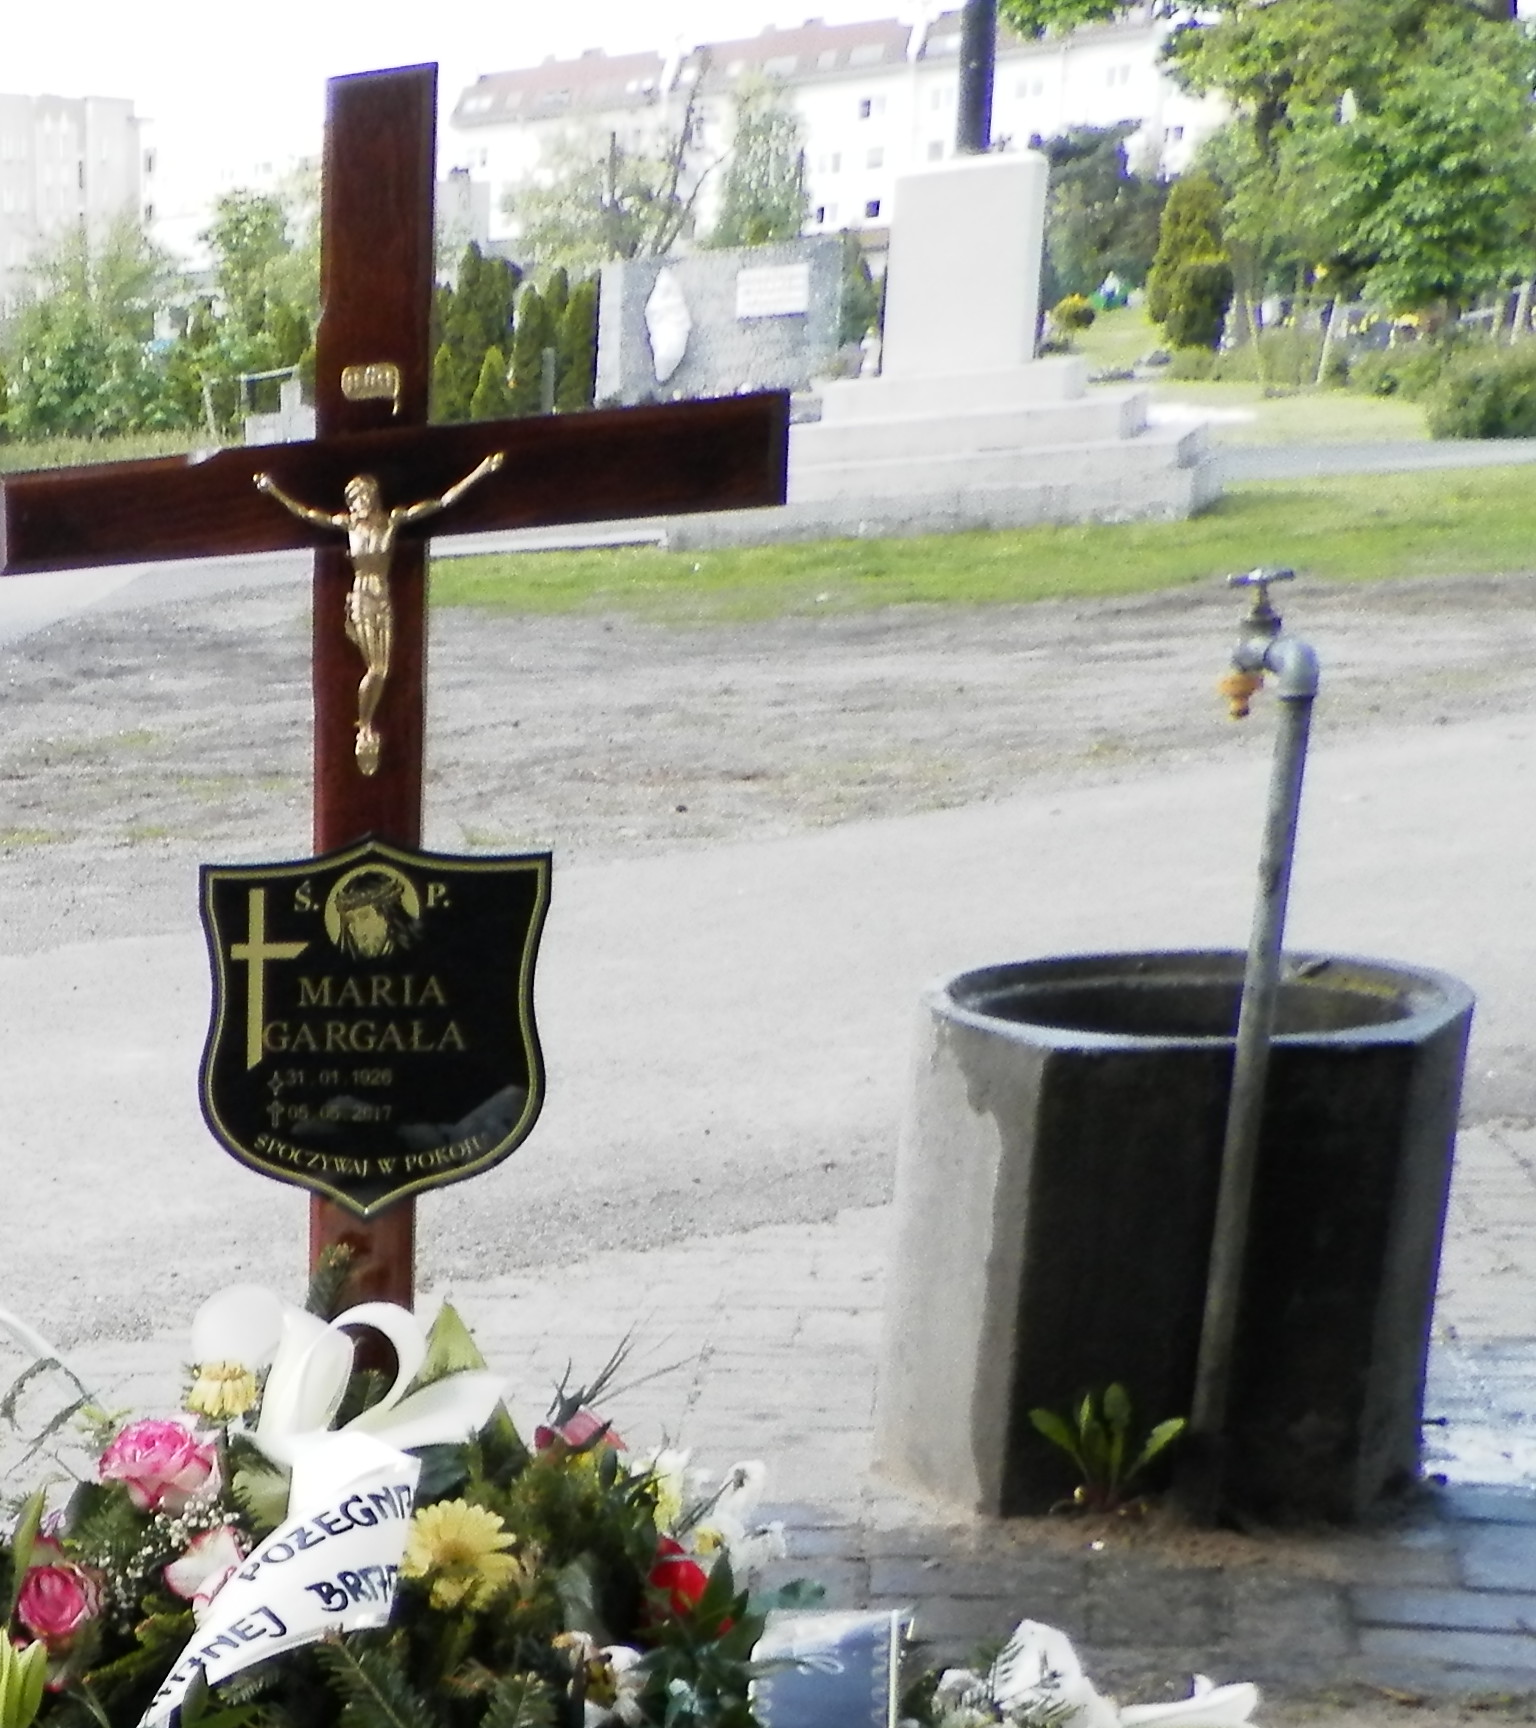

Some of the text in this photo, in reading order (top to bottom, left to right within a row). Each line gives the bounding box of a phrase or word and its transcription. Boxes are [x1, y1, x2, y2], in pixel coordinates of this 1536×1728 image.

[426, 882, 451, 908] P.
[297, 974, 446, 1007] MARIA
[264, 1021, 466, 1052] GARGAŁA
[254, 1132, 368, 1178] SPOCZYWAJ
[378, 1157, 396, 1174] W
